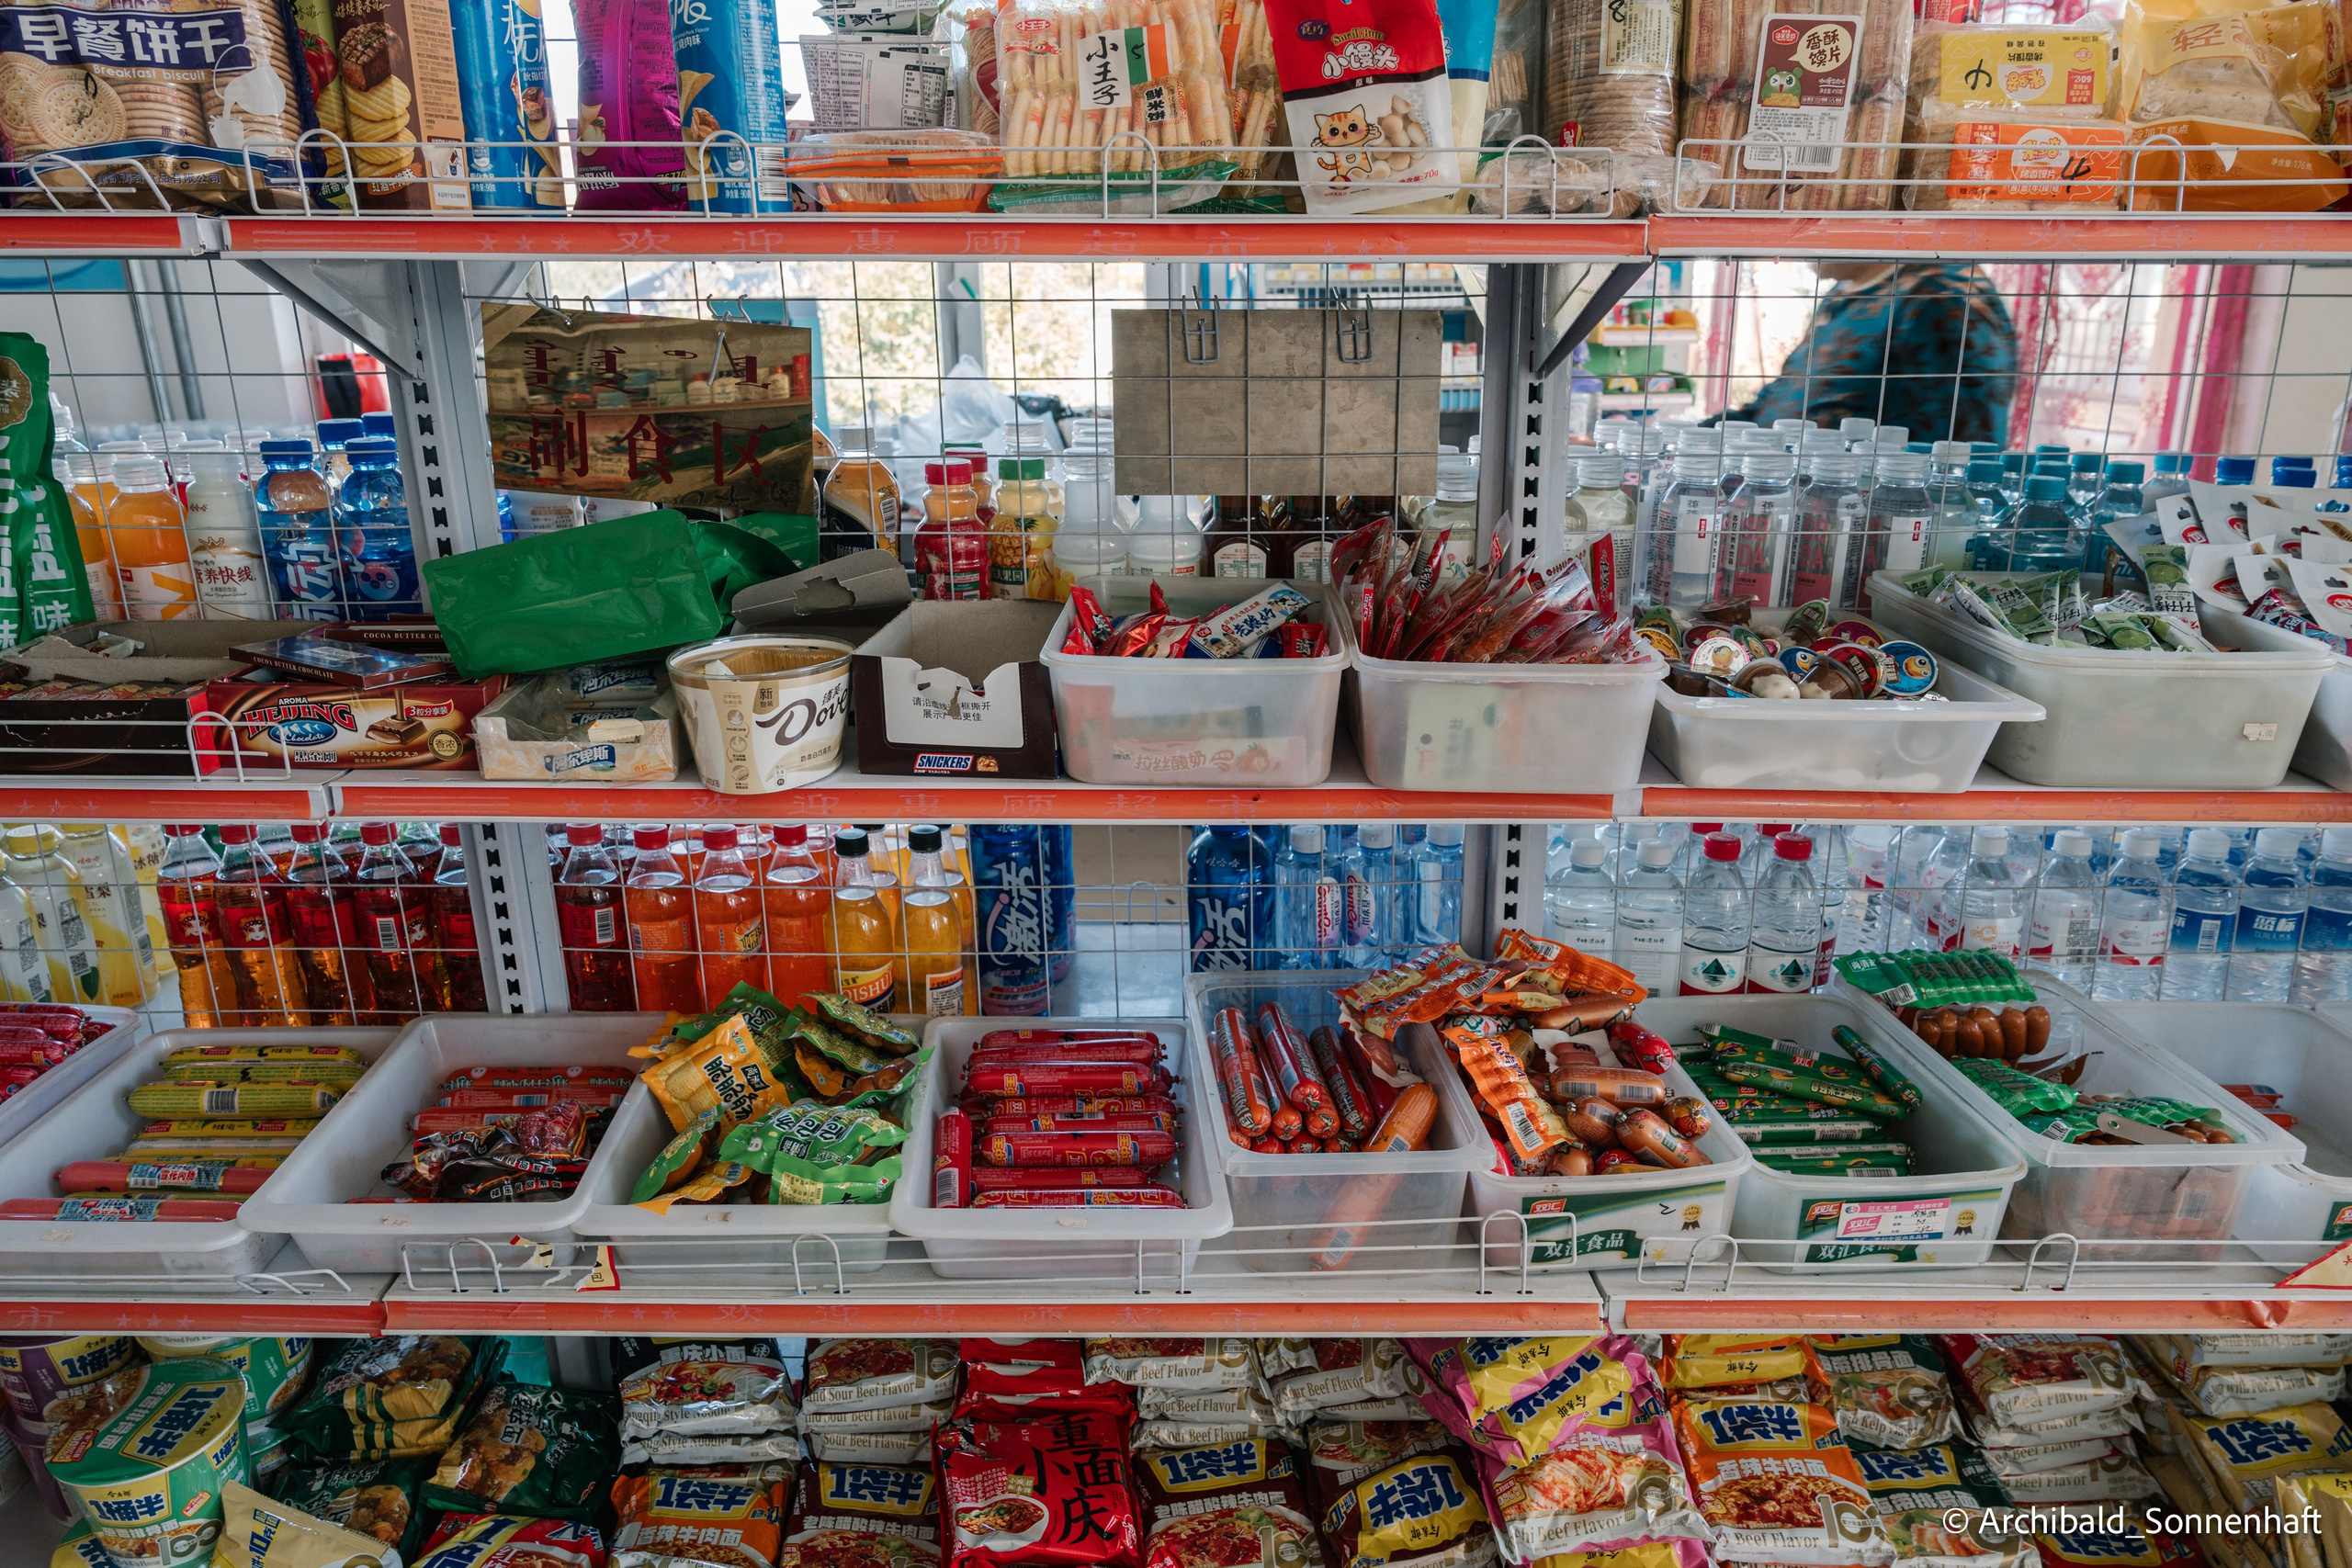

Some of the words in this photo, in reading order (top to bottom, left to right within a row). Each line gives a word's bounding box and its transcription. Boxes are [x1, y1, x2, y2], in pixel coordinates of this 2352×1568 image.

[1016, 20, 1051, 30] 小王子
[17, 13, 231, 65] 早餐饼干
[1331, 29, 1361, 45] Small
[1364, 27, 1385, 40] Bun
[1805, 28, 1840, 50] 香酥
[1322, 41, 1399, 79] 小馒头
[1808, 45, 1841, 67] 馍片
[2007, 52, 2043, 62] 烤香馍片
[93, 63, 156, 80] Breakfast
[163, 70, 206, 81] biscuit
[1085, 36, 1120, 106] 小王子
[1355, 77, 1374, 87] 原味
[1145, 86, 1166, 122] 鲜米饼
[161, 125, 190, 138] 原味
[1199, 139, 1224, 149] 82克
[1238, 168, 1261, 179] 82克
[2270, 157, 2313, 172] 净含量:176克
[529, 408, 774, 488] 副食区
[1234, 606, 1277, 638] 老酸奶
[363, 632, 389, 640] COCOA
[394, 632, 424, 640] BUTTER
[253, 656, 273, 667] COCOA
[275, 660, 296, 671] BUTTER
[298, 665, 334, 680] CHOCOLATE
[277, 697, 308, 705] AROMA
[759, 687, 774, 701] 新
[912, 696, 991, 711] 请沿虚线框撕开
[246, 702, 358, 739] HEIJING
[409, 705, 449, 717] 3粒分享装
[755, 687, 849, 746] Dove
[284, 731, 327, 744] Chocolate
[435, 739, 456, 750] 香浓
[551, 745, 609, 778] 阿尔卑斯
[800, 745, 832, 762] 奶香白巧克力
[917, 755, 972, 770] SNICKERS
[2252, 914, 2296, 933] 蓝标
[702, 1054, 754, 1122] 脆脆肠
[1533, 1201, 1562, 1214] 双汇
[1848, 1218, 1878, 1230] 双汇
[660, 1345, 747, 1364] 重庆小面
[1115, 1364, 1139, 1380] Sour
[1141, 1364, 1166, 1380] Beef
[1168, 1362, 1203, 1378] Flavor
[828, 1386, 849, 1401] Sour
[851, 1383, 878, 1399] Beef
[880, 1381, 915, 1397] Flavor
[1283, 1387, 1306, 1403] Sour
[1307, 1382, 1329, 1399] Beef
[1331, 1377, 1364, 1395] Flavor
[851, 1409, 876, 1422] Beef
[876, 1407, 910, 1422] Flavor
[1178, 1398, 1201, 1412] Beef
[1203, 1397, 1237, 1414] Flavor
[1701, 1404, 1804, 1445] 1袋半
[850, 1435, 874, 1448] Beef
[875, 1434, 909, 1450] Flavor
[1188, 1429, 1212, 1443] Beef
[1213, 1427, 1248, 1443] Flavor
[1556, 1434, 1645, 1454] 菜牛肉面
[2206, 1419, 2314, 1464] 1袋半
[1158, 1441, 1260, 1486] 1袋半
[1716, 1457, 1831, 1483] 香辣牛肉面
[1860, 1447, 1951, 1482] 1袋半
[828, 1468, 924, 1506] 1袋半
[2014, 1476, 2044, 1488] Beef
[2046, 1473, 2087, 1487] Flavor
[653, 1477, 754, 1512] 1袋半
[1366, 1464, 1467, 1529] 1袋半
[89, 1491, 166, 1522] 1桶半
[1154, 1491, 1286, 1519] 老陈醋酸辣牛肉面
[640, 1525, 744, 1548] 香辣牛肉面
[802, 1515, 936, 1540] 老陈醋酸辣牛肉面
[1536, 1519, 1572, 1543] Beef
[1573, 1513, 1623, 1538] Flavor
[1744, 1531, 1770, 1548] Beef
[1771, 1533, 1820, 1549] Flavor
